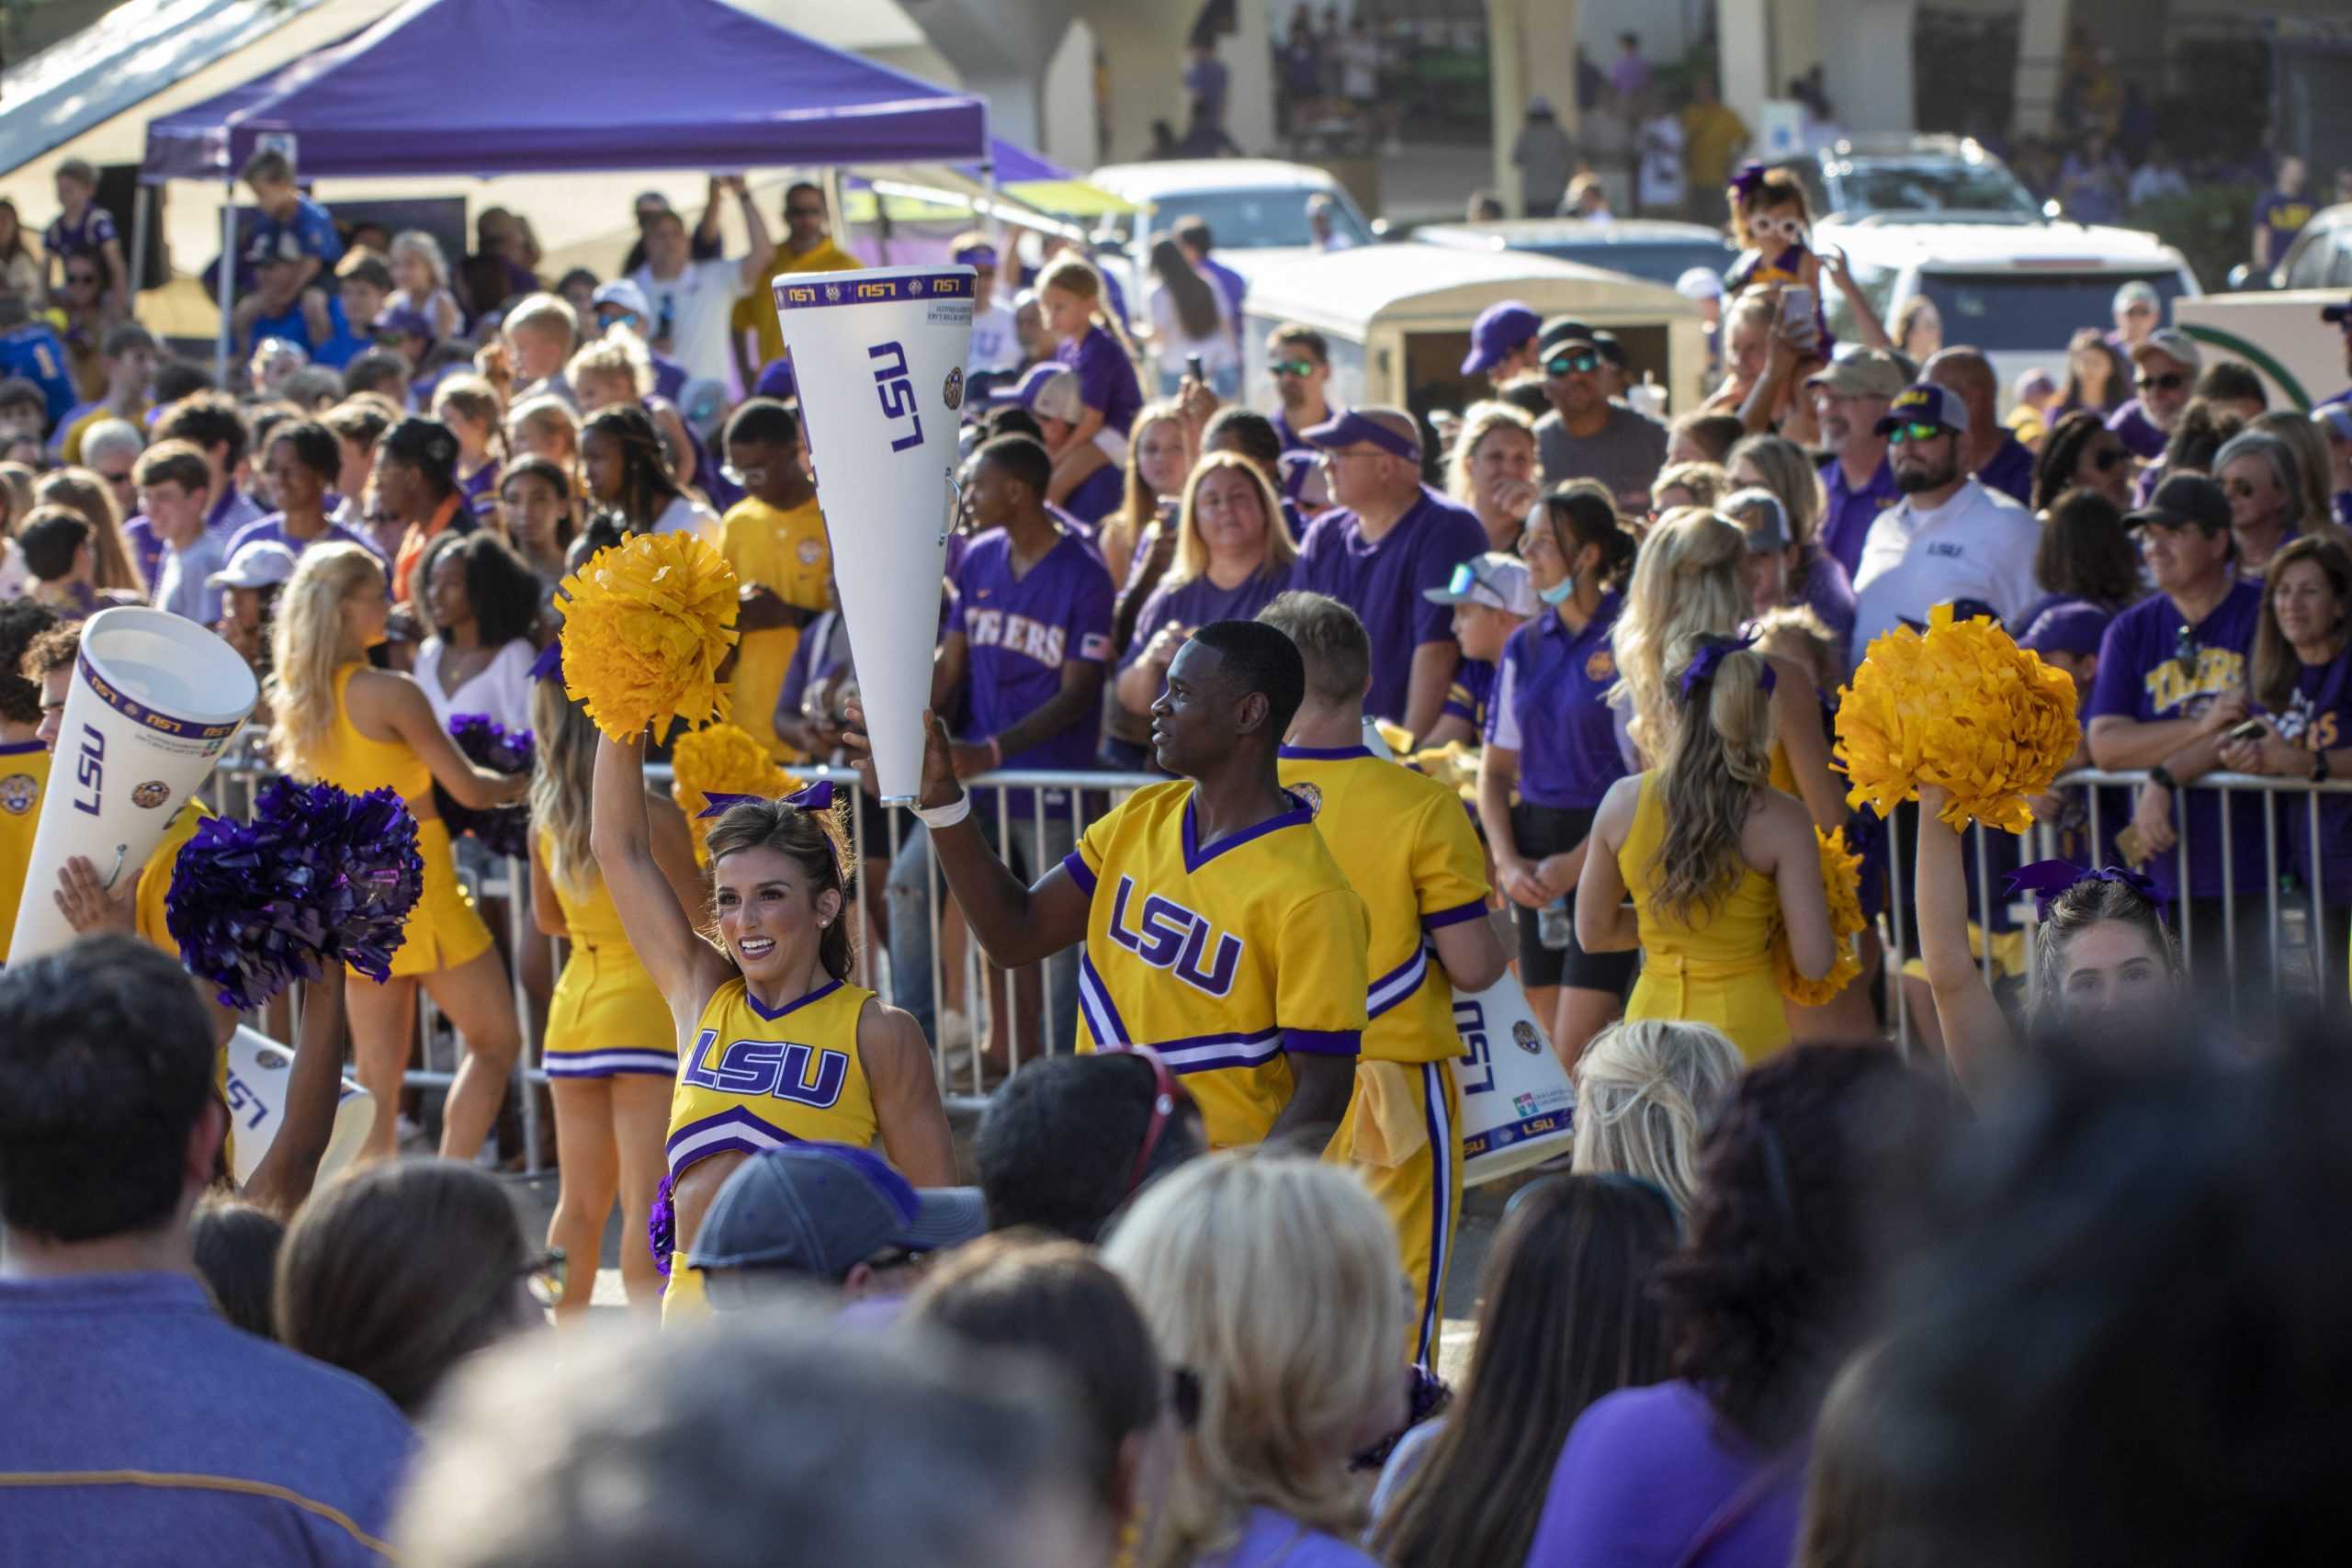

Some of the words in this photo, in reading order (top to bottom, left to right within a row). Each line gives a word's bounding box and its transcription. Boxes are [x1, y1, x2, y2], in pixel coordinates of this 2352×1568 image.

[788, 288, 816, 302] LSU
[858, 283, 897, 298] LSU
[933, 278, 959, 292] LSU
[868, 341, 924, 453] LSU
[1928, 541, 1964, 558] LSU
[93, 676, 118, 704] LSU
[146, 714, 182, 732] LSU
[74, 723, 105, 817] LSU
[1107, 873, 1244, 998] LSU
[1453, 999, 1495, 1095] LSU
[682, 1029, 850, 1110] LSU
[227, 1067, 268, 1130] LS
[1522, 1117, 1555, 1134] LSU
[1463, 1138, 1486, 1155] SU
